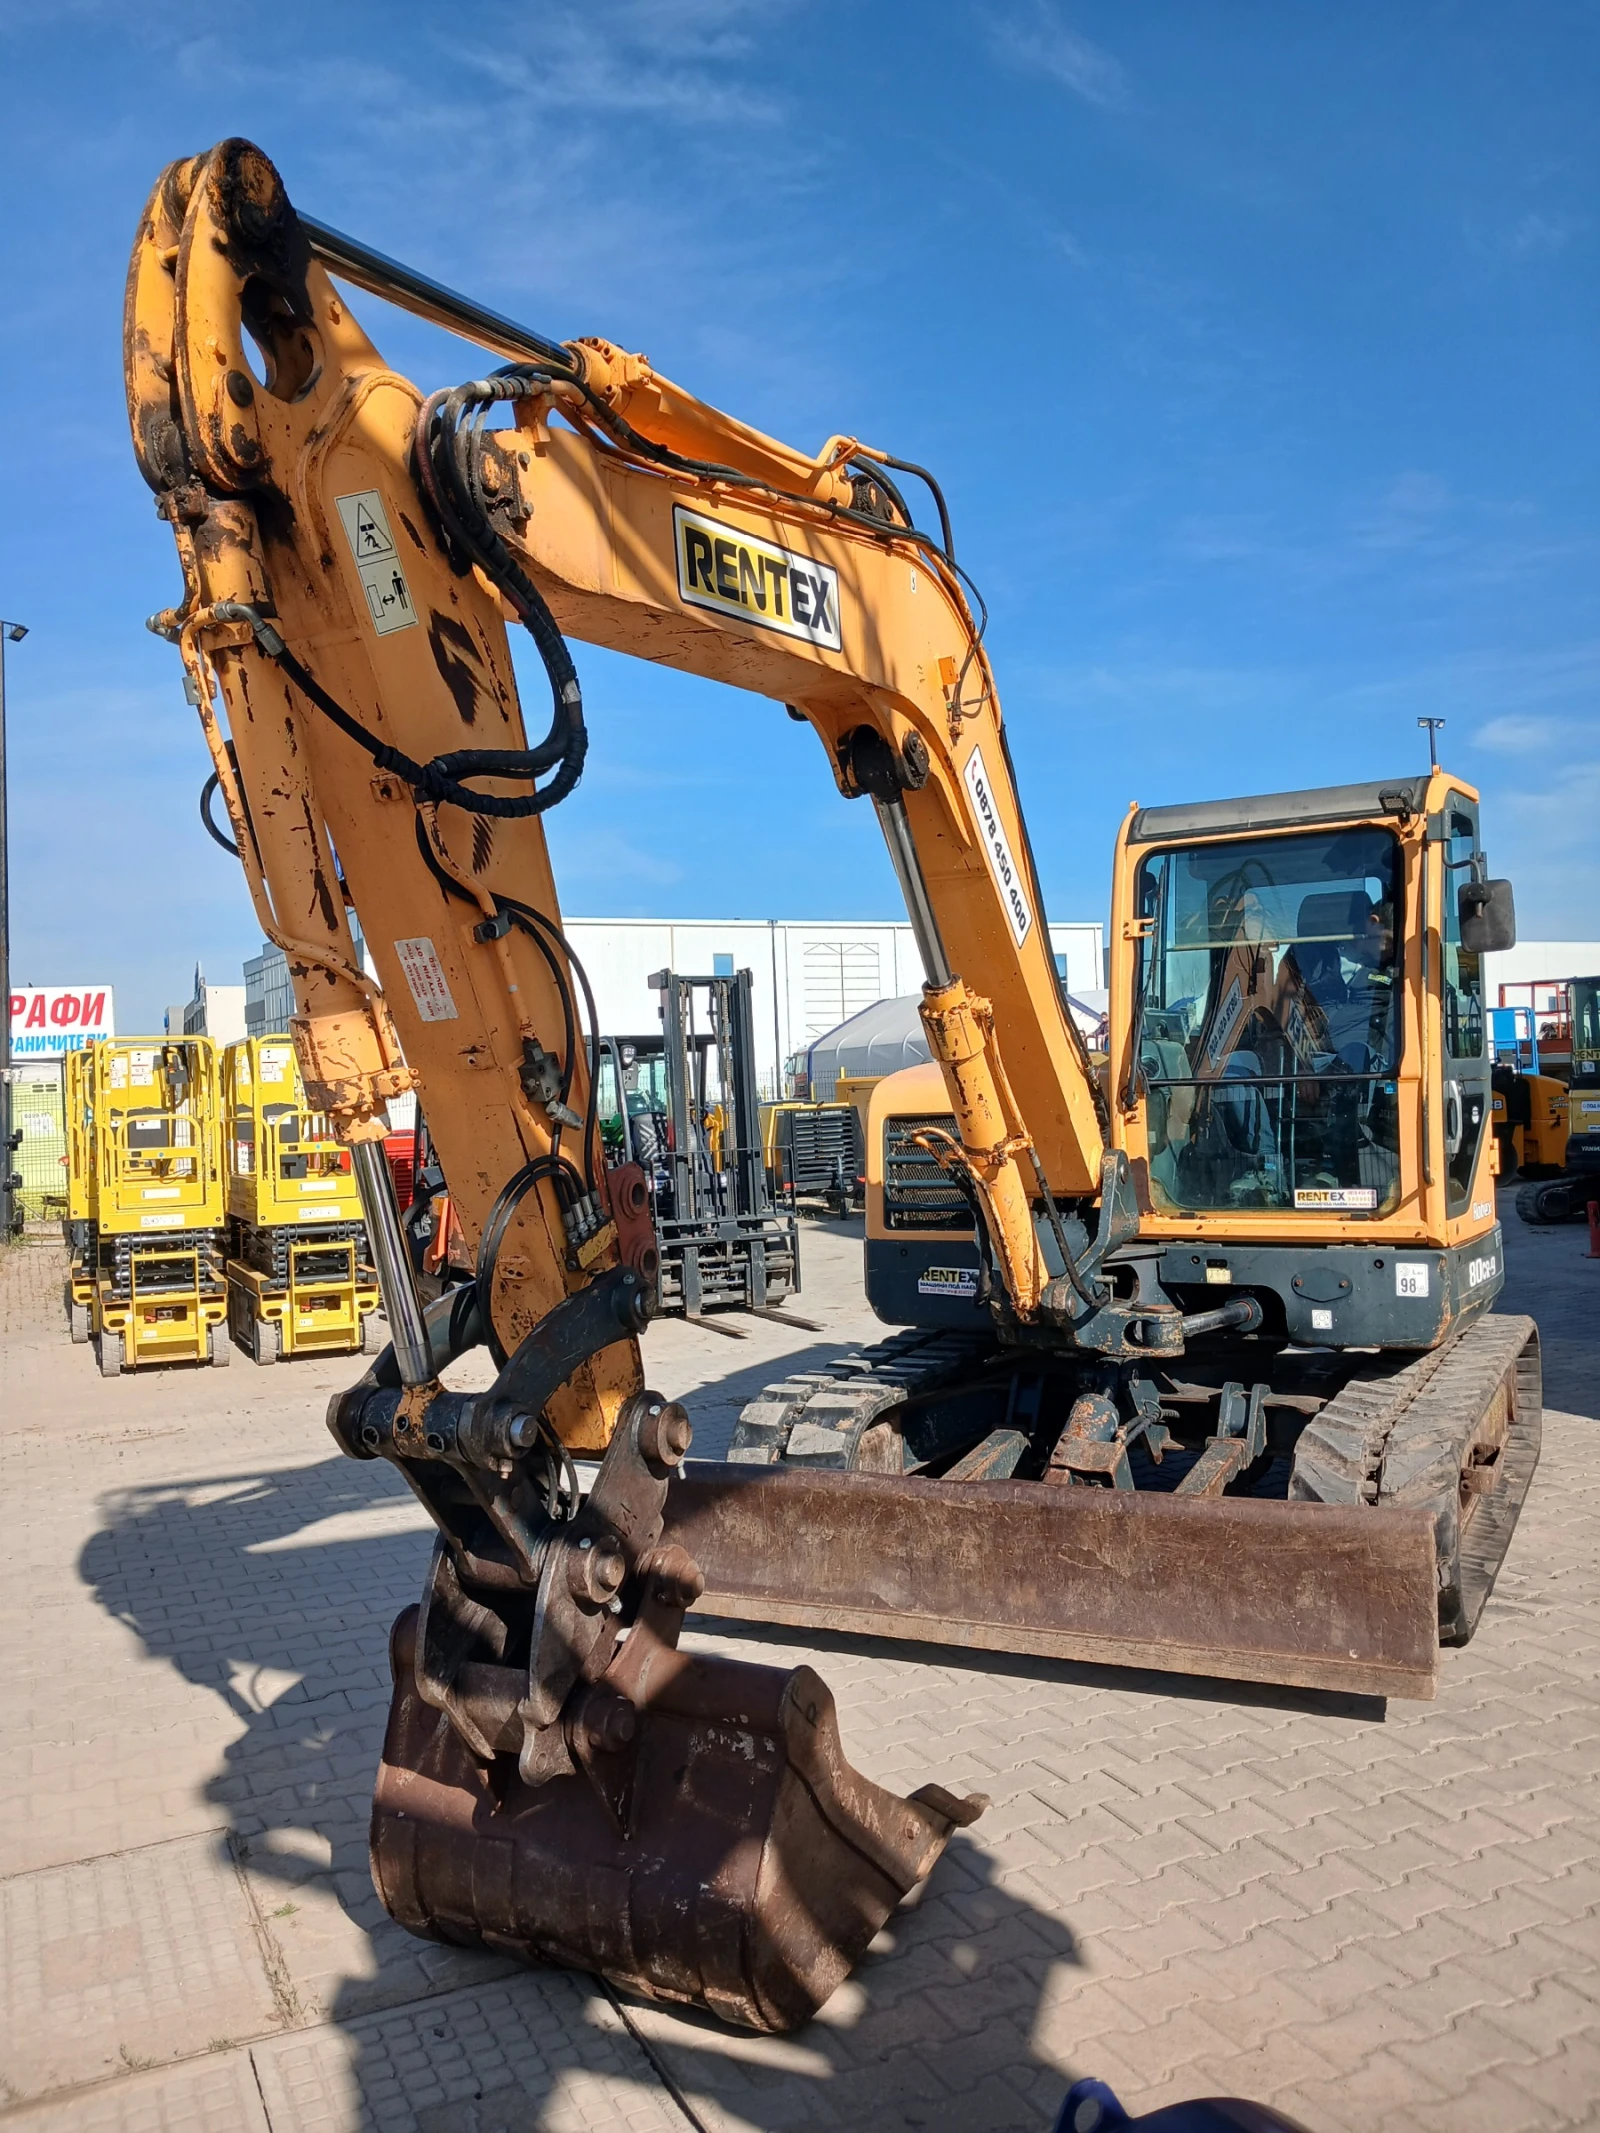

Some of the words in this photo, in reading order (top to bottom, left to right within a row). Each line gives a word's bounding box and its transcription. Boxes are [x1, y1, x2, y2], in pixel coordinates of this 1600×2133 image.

[684, 525, 833, 635] RENTEX
[975, 778, 997, 840] 0878
[994, 841, 1012, 887] 450
[1009, 888, 1027, 932] 400
[1297, 1191, 1346, 1202] RENTEX
[921, 1270, 976, 1283] RENTEX
[1400, 1277, 1417, 1294] 98
